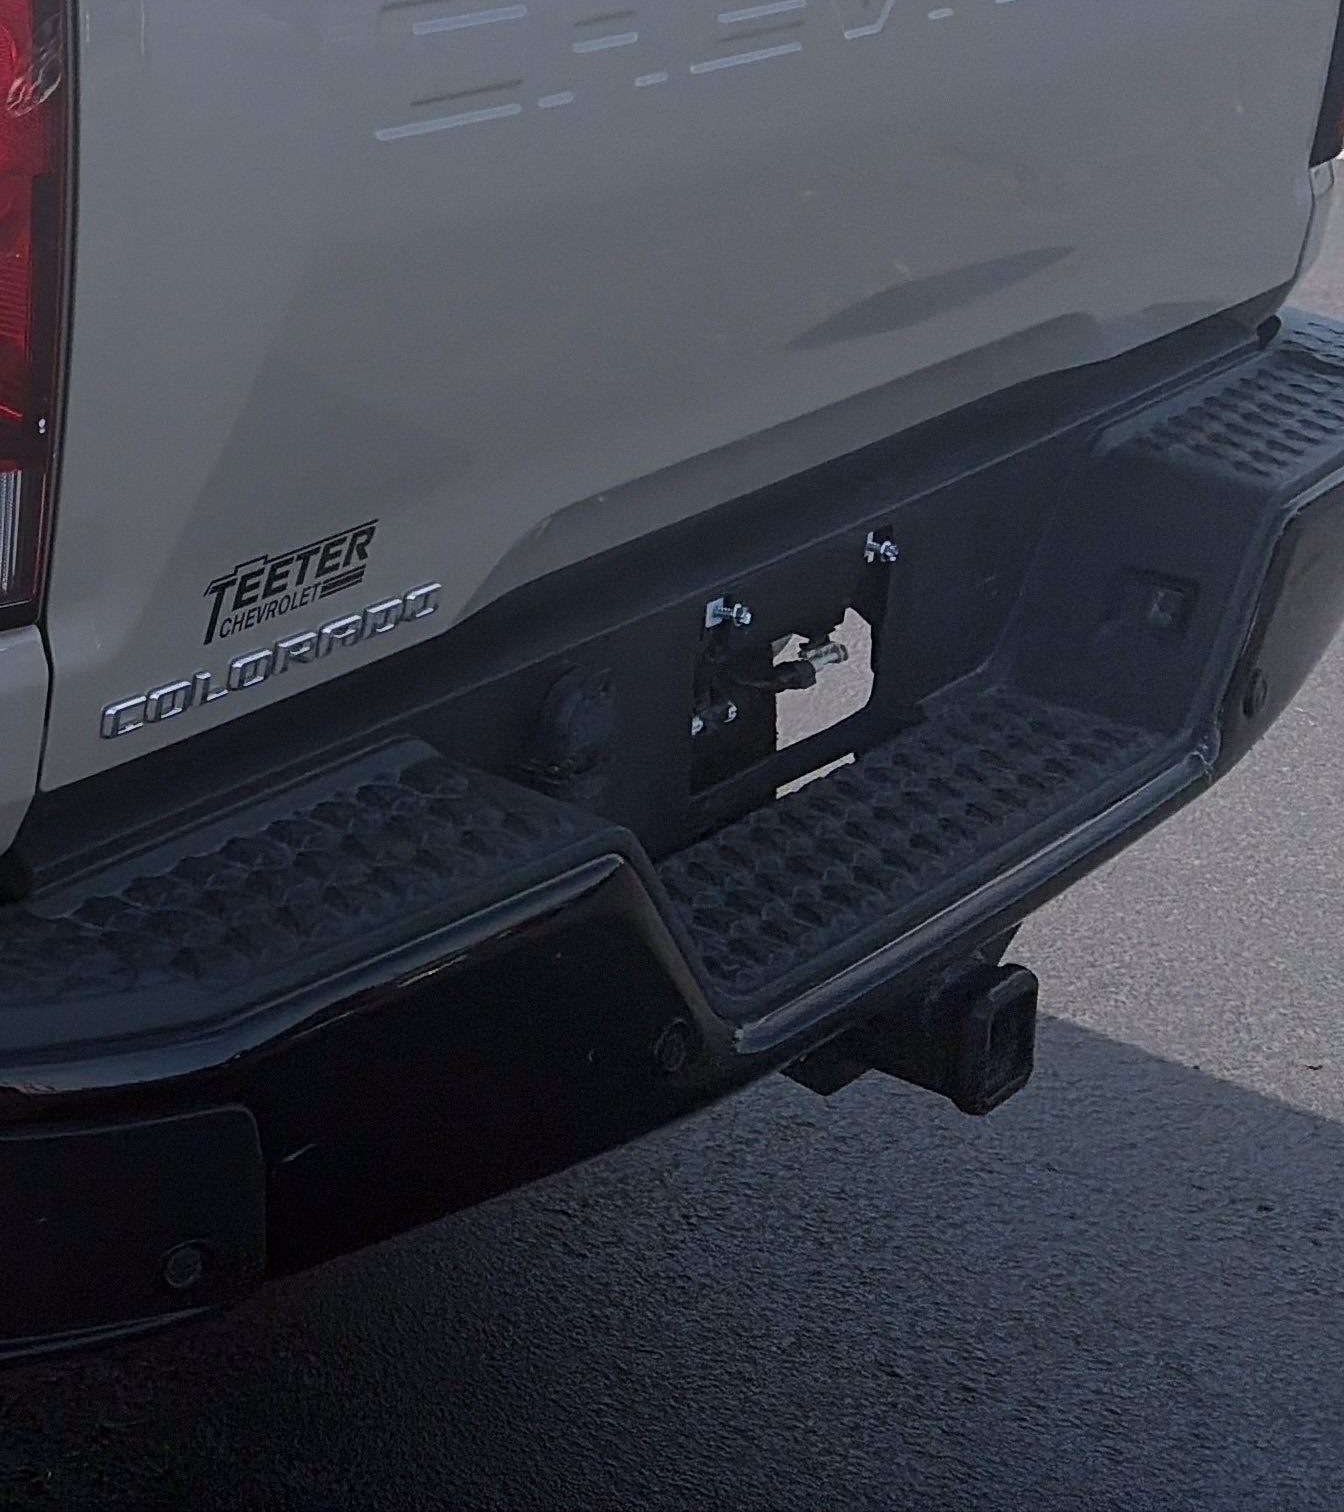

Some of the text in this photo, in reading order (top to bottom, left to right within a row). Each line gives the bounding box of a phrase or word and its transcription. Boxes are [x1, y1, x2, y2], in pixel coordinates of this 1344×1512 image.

[204, 522, 378, 645] TEETER
[219, 583, 321, 639] CHEVROLET
[100, 581, 442, 739] COLORADO
